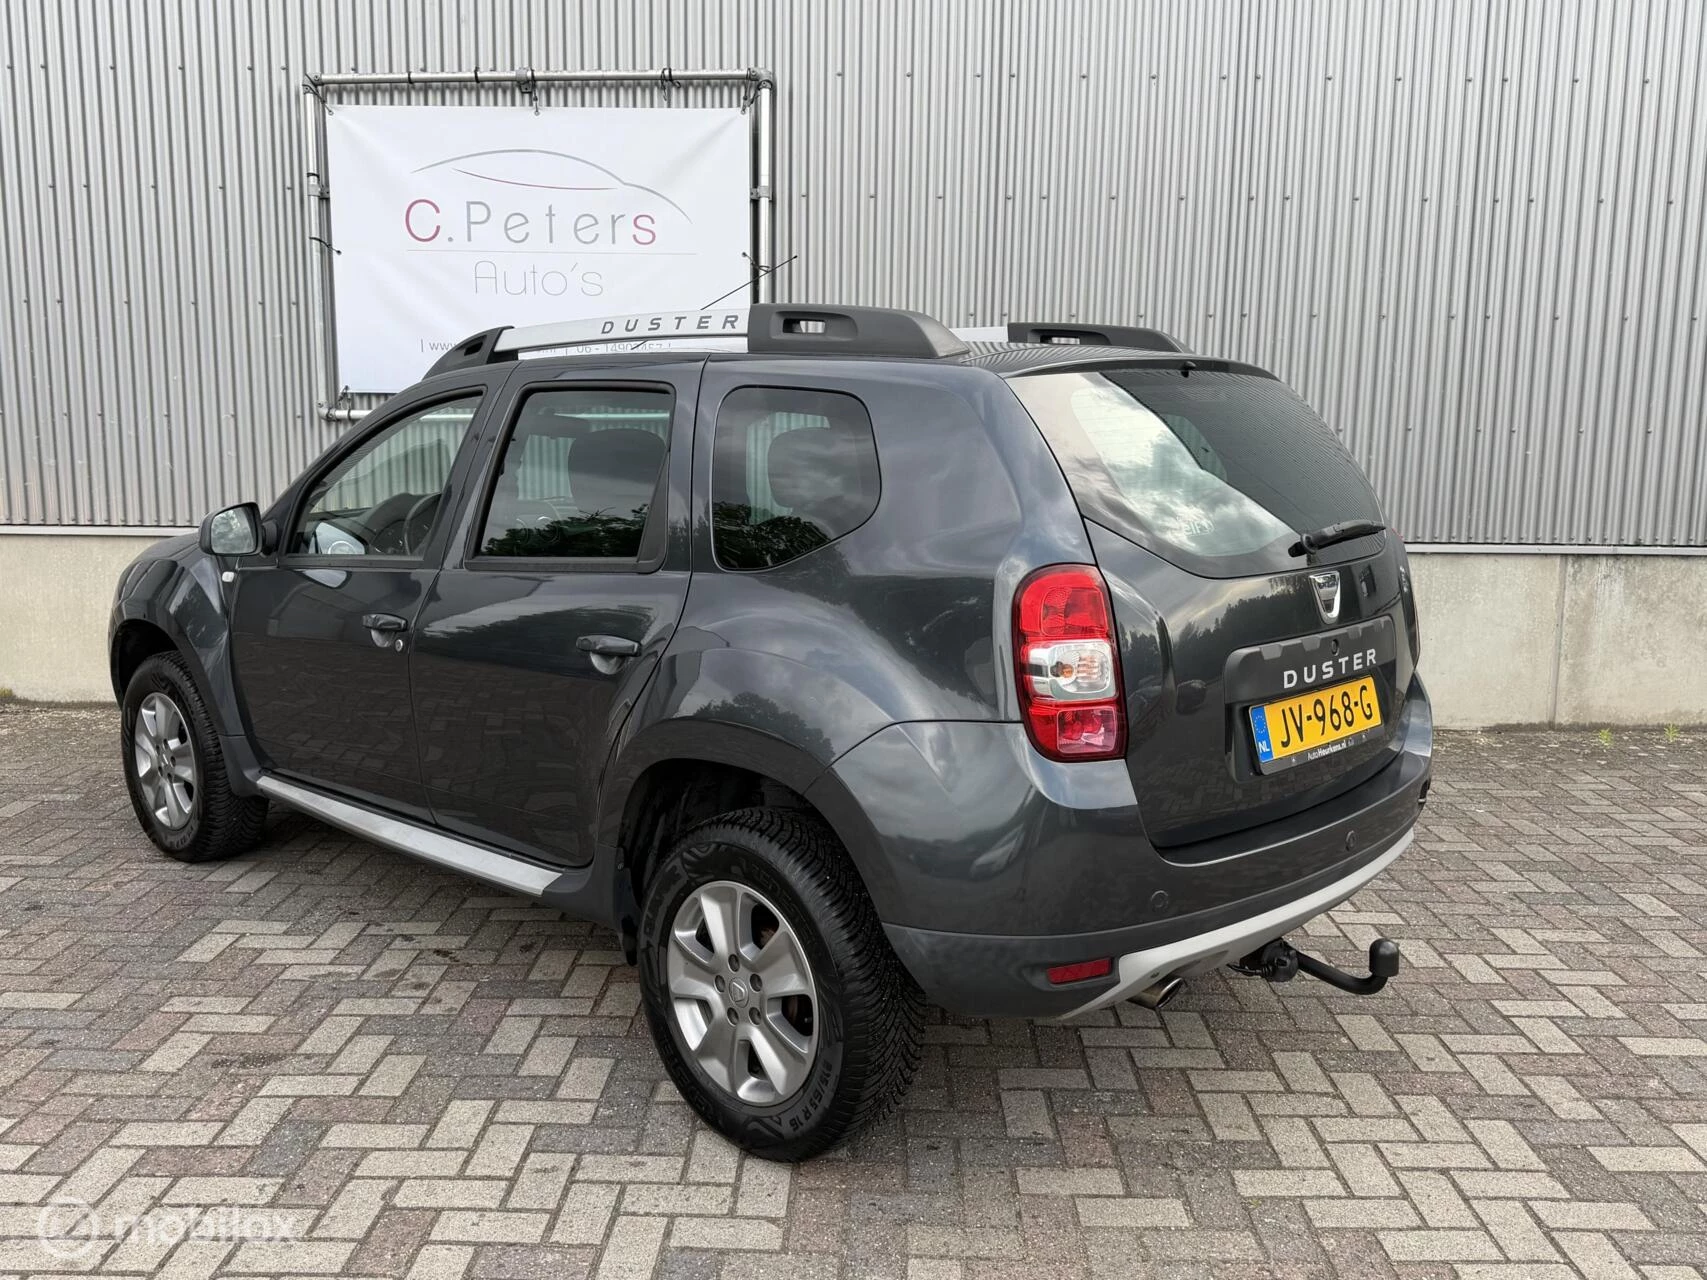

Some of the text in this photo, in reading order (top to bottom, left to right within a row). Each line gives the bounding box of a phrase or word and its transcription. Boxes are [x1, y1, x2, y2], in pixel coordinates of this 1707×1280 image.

[600, 314, 739, 335] DUSTER
[1283, 648, 1377, 689] DUSTER
[1280, 685, 1373, 748] JV-968-G
[1258, 740, 1271, 754] NL
